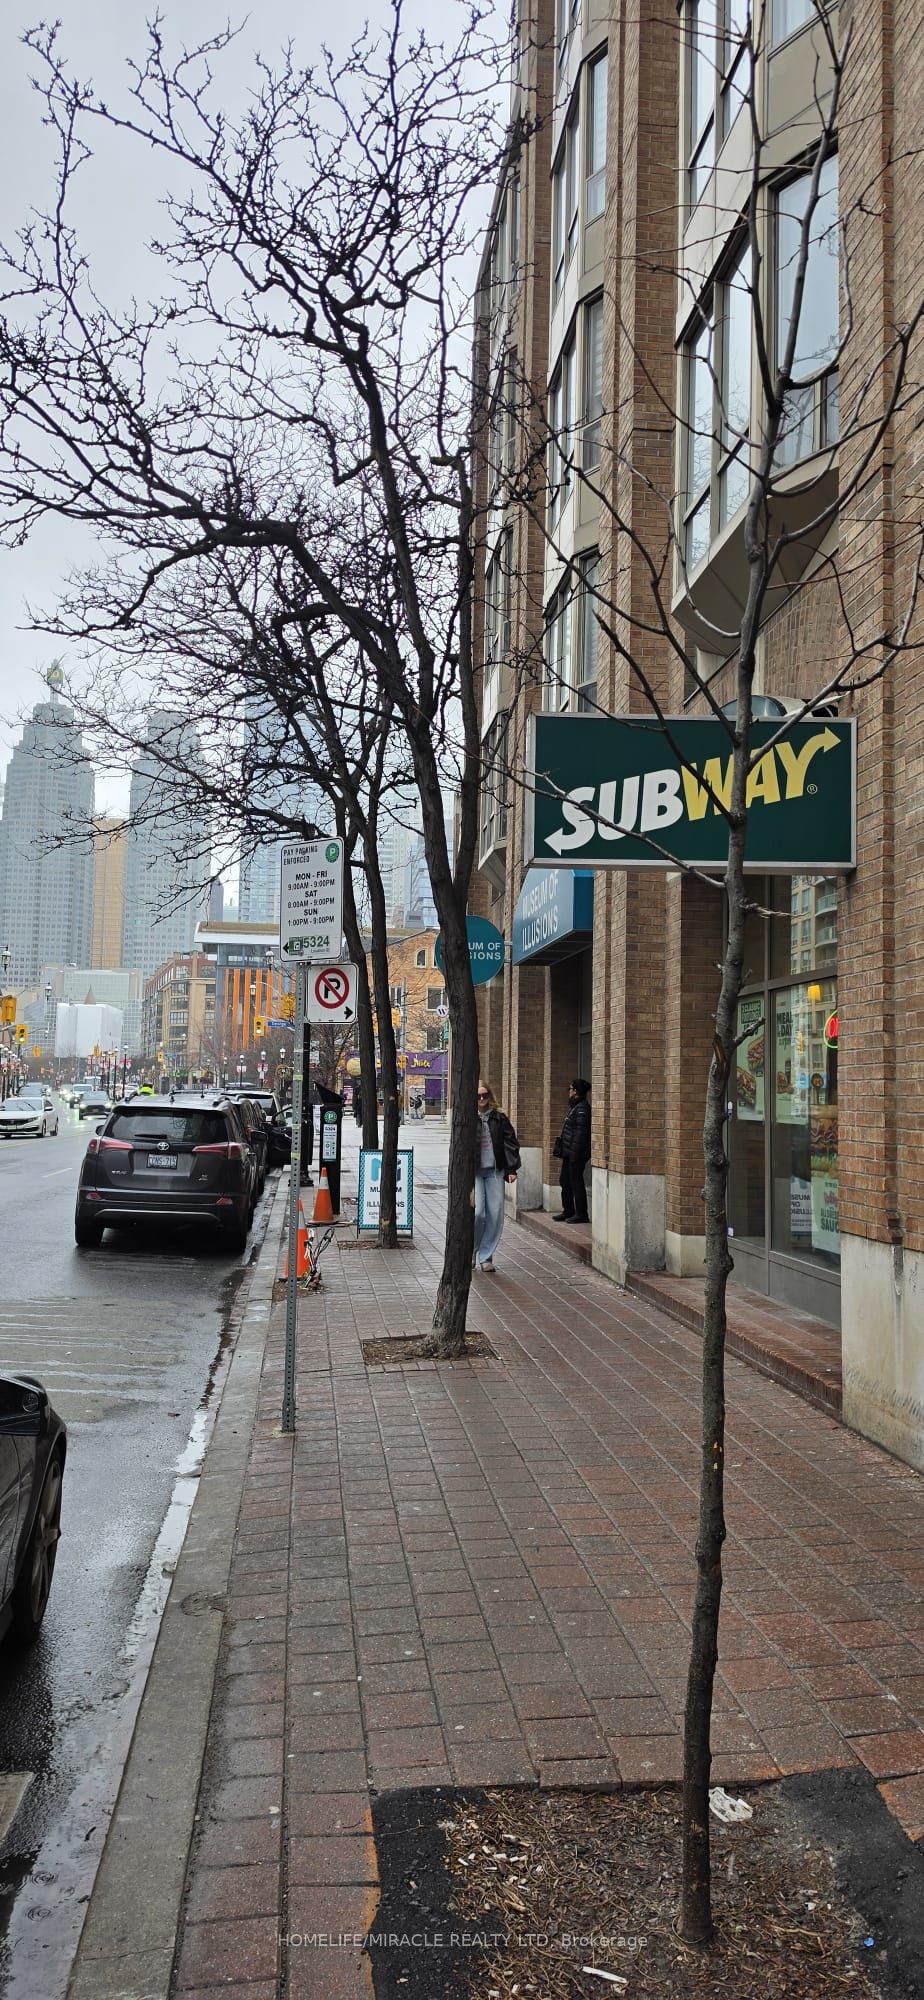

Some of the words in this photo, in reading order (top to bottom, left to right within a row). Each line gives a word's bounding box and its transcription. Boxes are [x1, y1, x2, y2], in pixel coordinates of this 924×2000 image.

[544, 727, 841, 856] SUBWAY
[283, 848, 294, 856] PAY
[284, 856, 310, 865] ENFORCED
[295, 872, 310, 880] MON
[316, 870, 328, 878] FRI
[304, 890, 318, 898] SAT
[522, 877, 548, 920] MUSEUM
[549, 870, 559, 900] OF
[304, 908, 318, 916] SUN
[522, 904, 559, 952] ILLUSIONS
[303, 936, 330, 948] 5324
[468, 942, 484, 950] UM
[488, 942, 502, 950] OF
